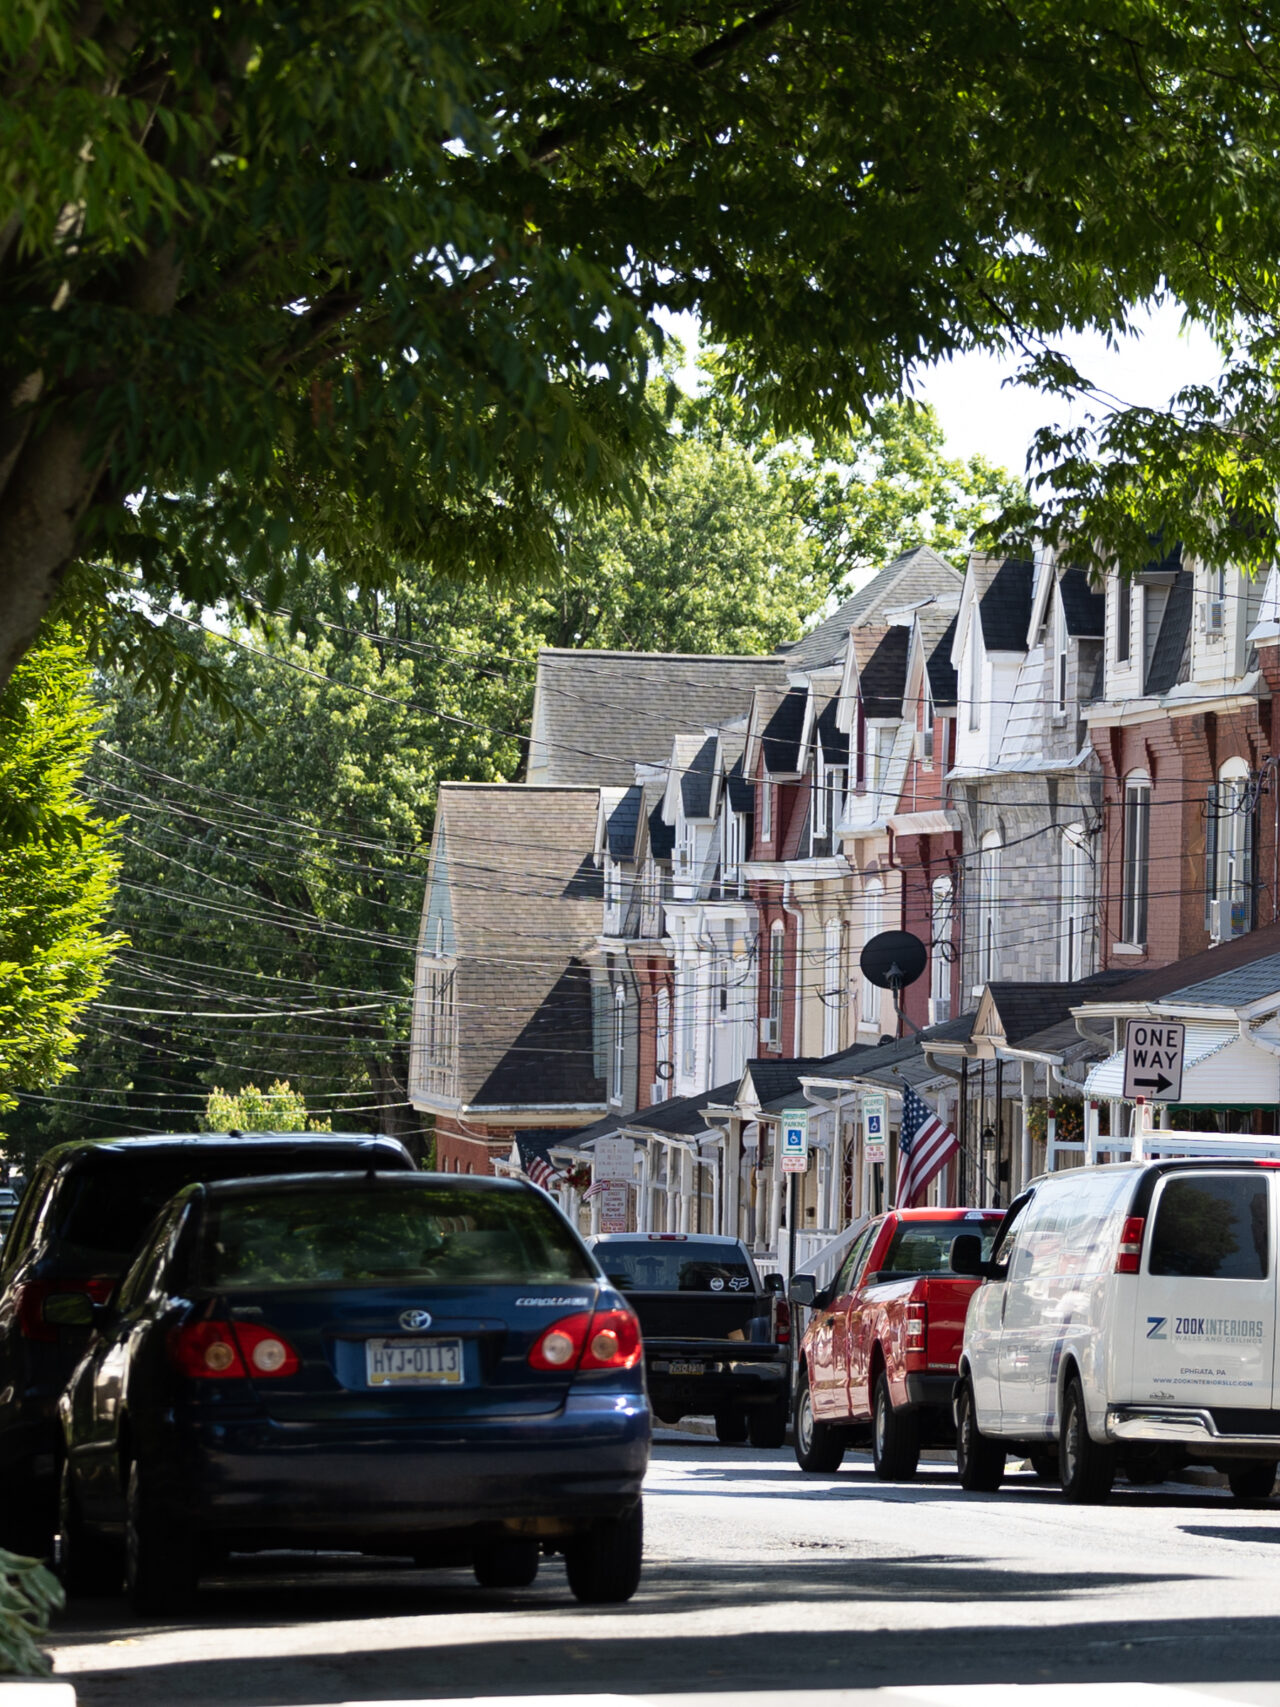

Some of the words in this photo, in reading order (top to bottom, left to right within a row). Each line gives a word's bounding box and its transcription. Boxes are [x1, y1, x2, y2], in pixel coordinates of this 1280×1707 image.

[1135, 1028, 1178, 1048] ONE
[1133, 1049, 1178, 1069] WAY
[515, 1297, 571, 1306] COROLLA
[1180, 1368, 1215, 1376] EPHRATA,
[1153, 1378, 1253, 1387] WWW.ZOOKINTERIORSLLC.COM
